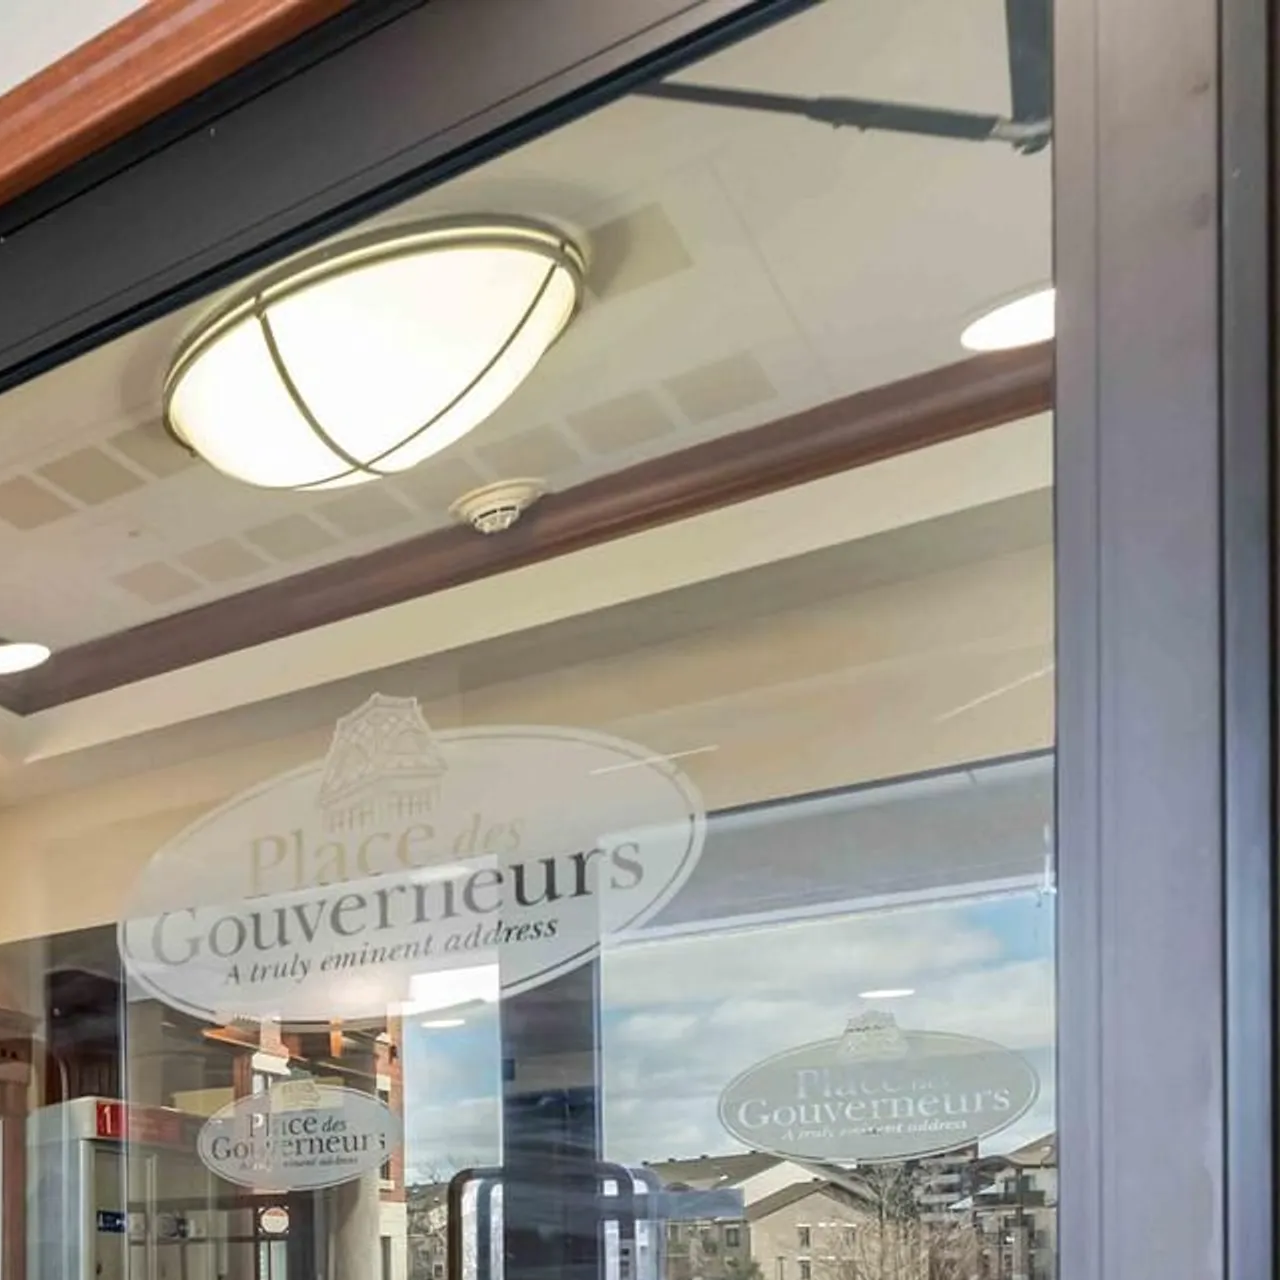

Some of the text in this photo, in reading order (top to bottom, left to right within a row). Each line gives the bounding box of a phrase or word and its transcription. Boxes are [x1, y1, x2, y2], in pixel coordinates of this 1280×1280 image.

[244, 812, 526, 899] Place des
[151, 841, 646, 967] Gouverneurs
[248, 952, 311, 984] truly
[319, 936, 434, 973] eminent
[444, 914, 559, 952] address
[738, 1088, 1011, 1130] Gouverneurs
